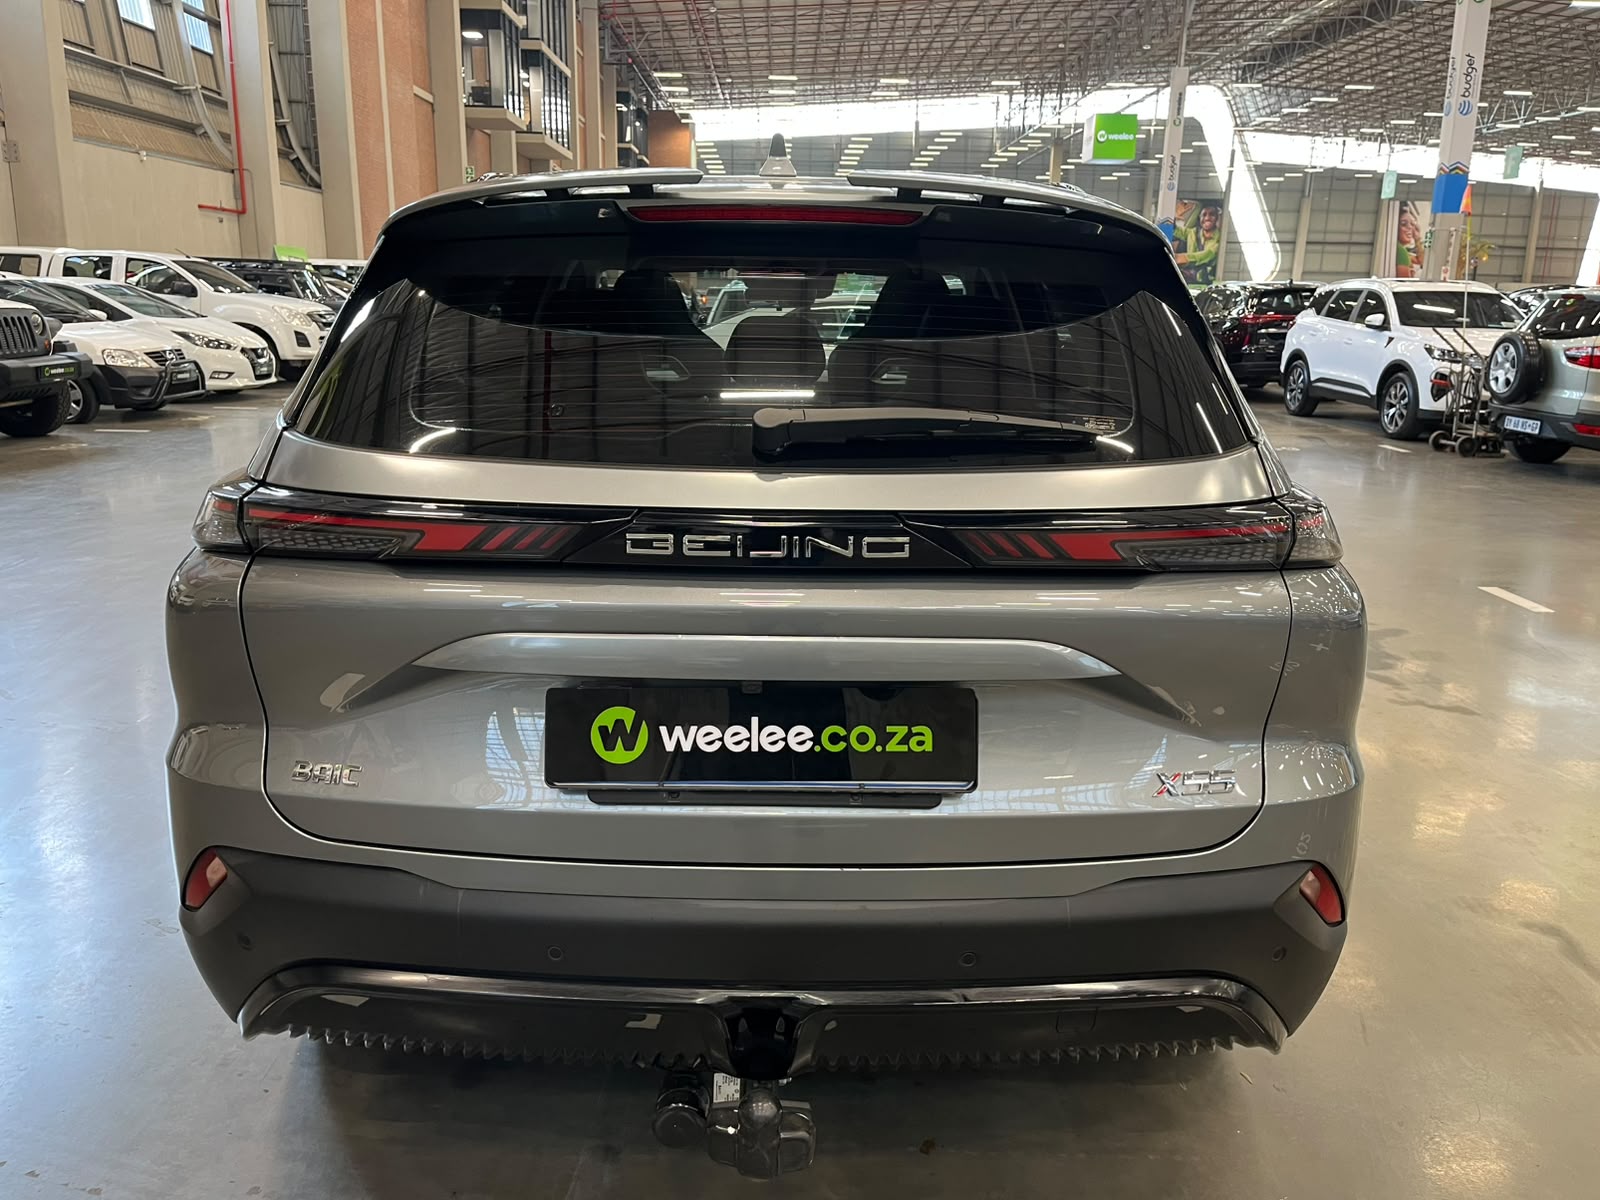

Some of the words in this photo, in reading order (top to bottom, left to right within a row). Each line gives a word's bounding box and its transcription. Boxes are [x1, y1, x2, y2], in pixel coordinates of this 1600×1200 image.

[1460, 53, 1478, 98] budget
[626, 533, 910, 558] BEIJING
[659, 716, 933, 753] weelee.co.za
[292, 760, 362, 787] BAIC
[1152, 769, 1236, 797] X55
